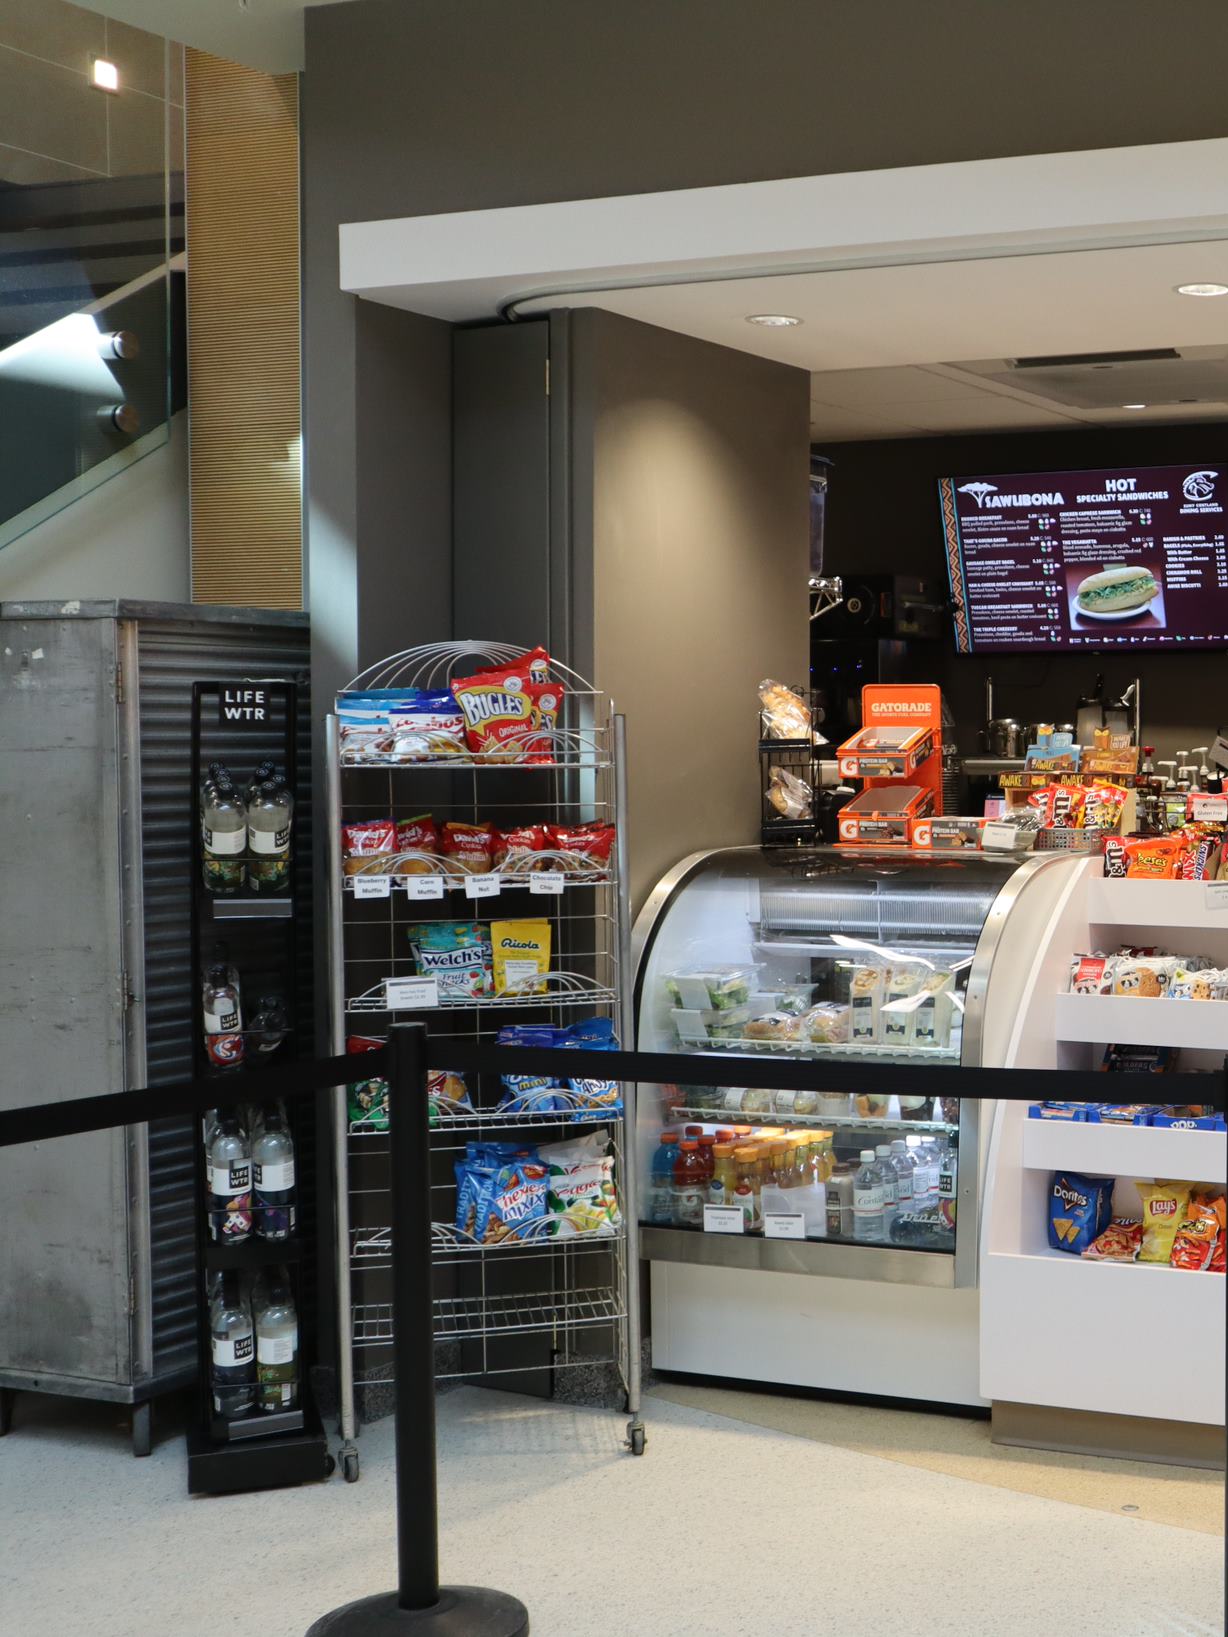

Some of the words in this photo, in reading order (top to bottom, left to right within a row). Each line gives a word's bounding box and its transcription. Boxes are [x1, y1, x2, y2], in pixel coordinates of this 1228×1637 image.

[1105, 479, 1137, 492] HOT
[985, 492, 1065, 508] SAWUBONA
[1076, 494, 1116, 503] SPECIALTY
[1117, 491, 1169, 501] SANDWICHES
[225, 690, 265, 703] LIFE
[225, 707, 265, 720] WTR
[460, 691, 524, 727] BUGLES
[871, 703, 932, 713] GATORADE
[499, 723, 528, 737] ORIGINAL
[841, 758, 858, 776] G
[1000, 775, 1023, 787] AWAKE
[1061, 775, 1084, 786] AWAKE
[348, 829, 387, 840] David's
[840, 820, 858, 839] G
[914, 826, 931, 845] G
[454, 833, 492, 843] David's
[1194, 843, 1208, 880] SNICKERS
[357, 877, 388, 886] Blueberry
[532, 874, 563, 883] Chocolate
[361, 887, 384, 895] Muffin
[417, 888, 438, 896] Muffin
[539, 884, 554, 892] Chip
[500, 937, 540, 950] Ricola
[423, 949, 481, 967] Welch's
[442, 972, 466, 982] Fruit
[222, 1015, 238, 1023] LIFE
[222, 1021, 238, 1029] WTR
[519, 1077, 547, 1090] mini
[231, 1170, 248, 1179] LIFE
[231, 1178, 248, 1186] WTR
[1053, 1185, 1088, 1206] Doritos
[1152, 1199, 1177, 1214] Lay's
[235, 1339, 252, 1349] LIFE
[235, 1347, 252, 1356] WTR
